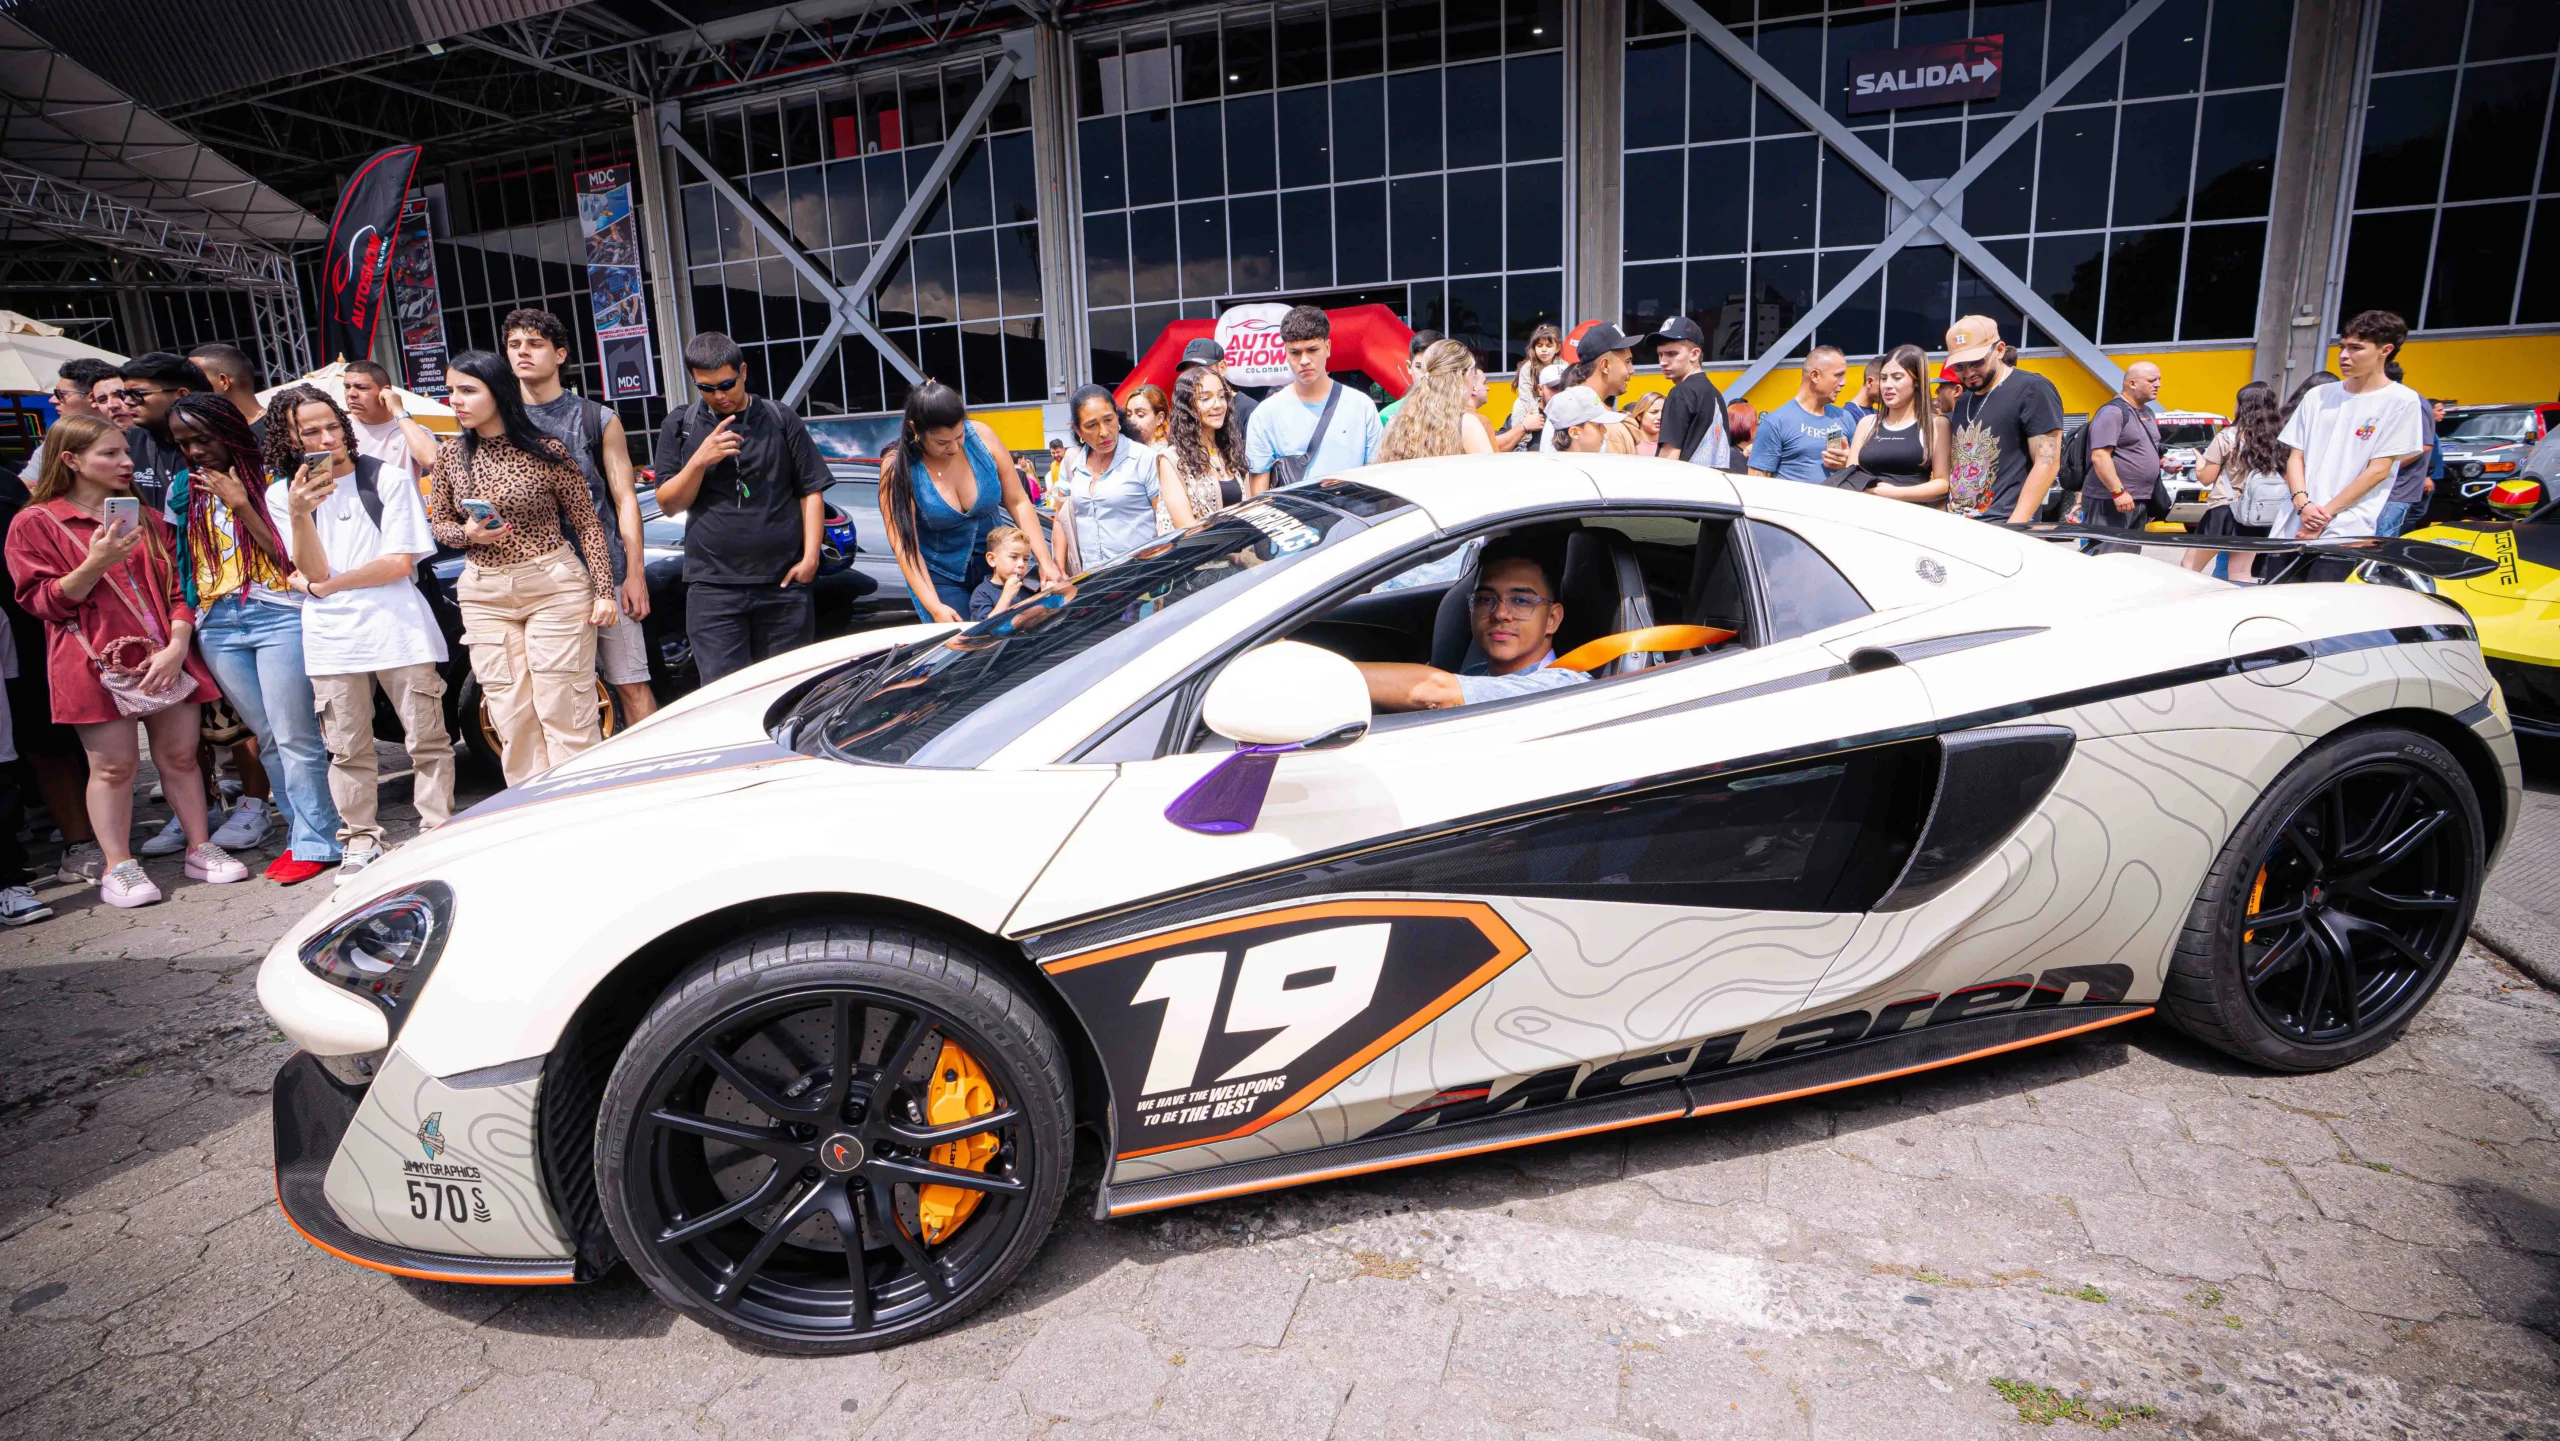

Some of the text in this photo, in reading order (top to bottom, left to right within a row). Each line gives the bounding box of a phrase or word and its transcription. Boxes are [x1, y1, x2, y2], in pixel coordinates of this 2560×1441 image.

[1856, 63, 1970, 95] SALIDA
[589, 169, 615, 186] MDC
[351, 231, 382, 330] AUTOSHOW
[1225, 333, 1286, 350] AUTO
[1224, 349, 1287, 367] SHOW
[618, 375, 640, 388] MDC
[1130, 923, 1392, 1096] 19
[1137, 1075, 1287, 1111] WE HAVE THE WEAPONS
[1144, 1096, 1259, 1126] TO BE THE BEST
[402, 1160, 481, 1179] JIMMYGRAPHICS
